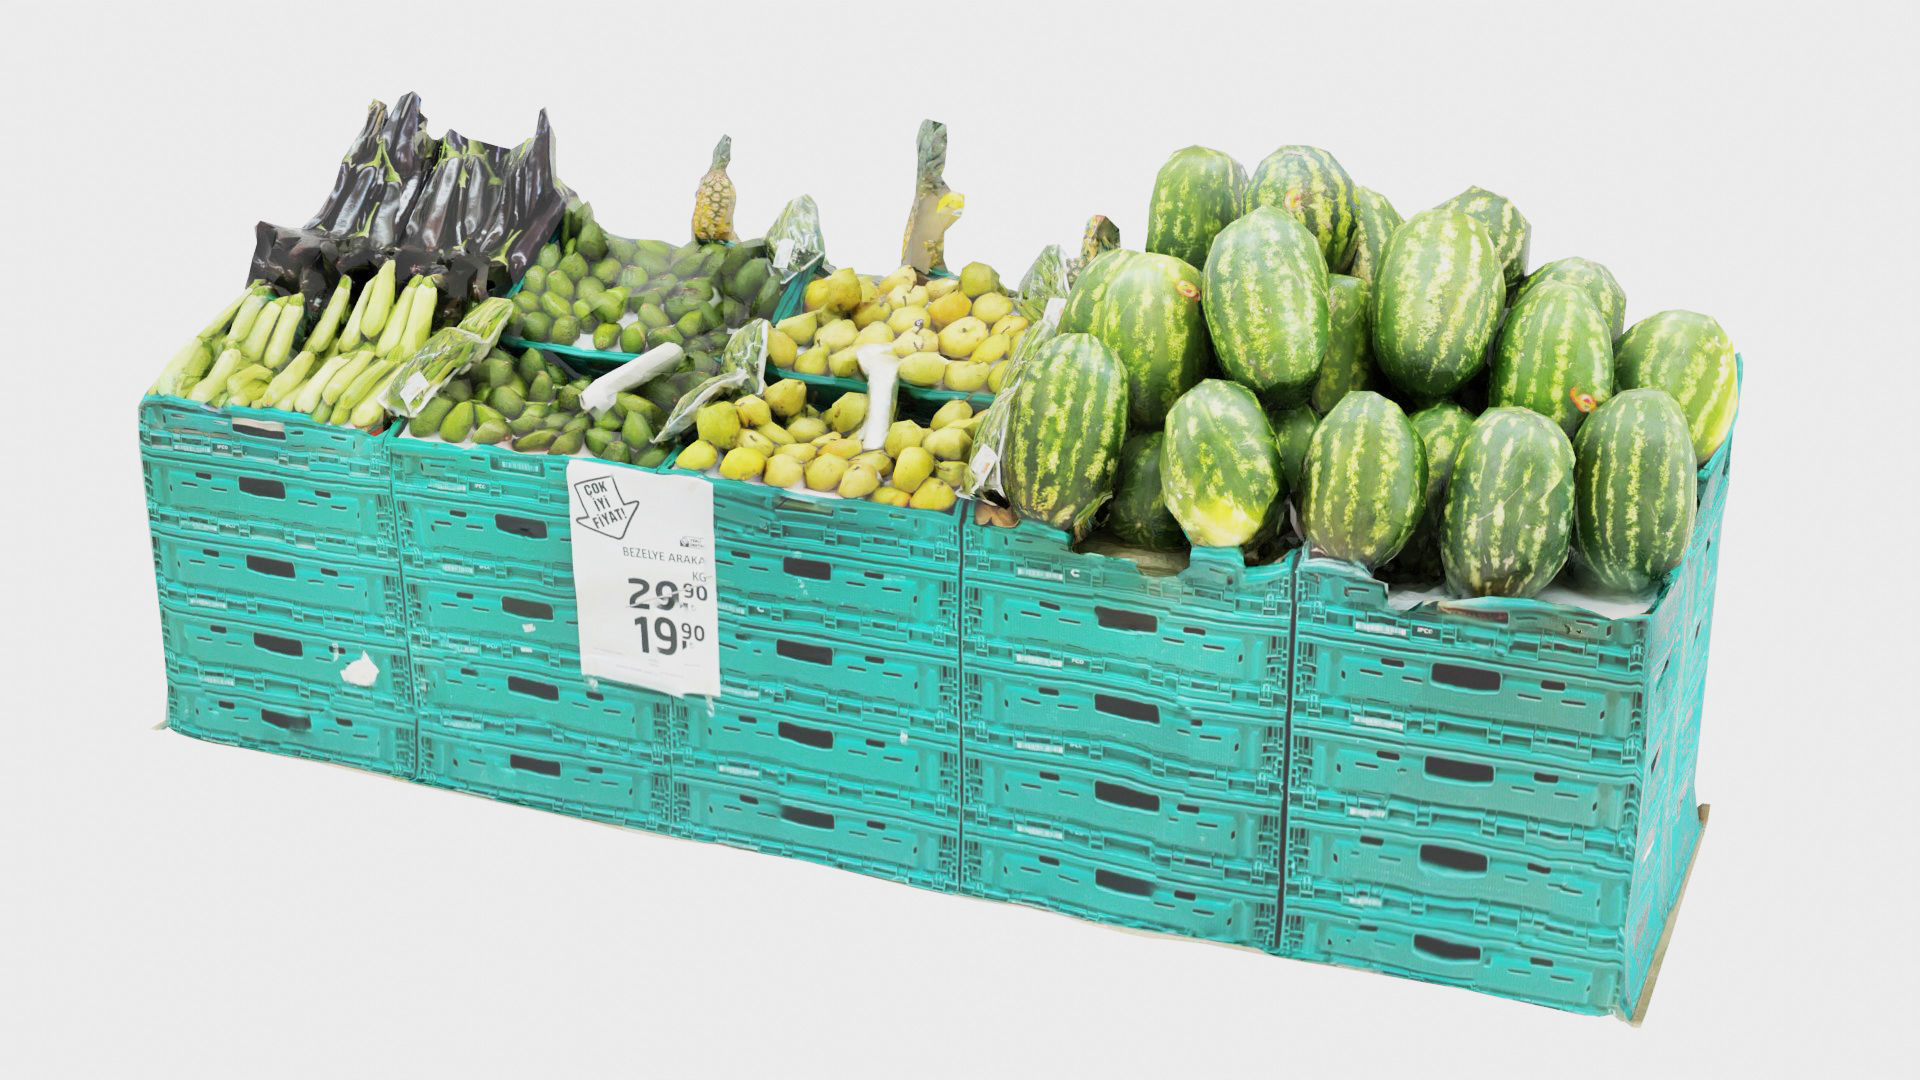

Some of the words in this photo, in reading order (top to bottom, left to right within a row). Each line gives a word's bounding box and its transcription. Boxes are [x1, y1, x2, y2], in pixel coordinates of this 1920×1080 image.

[583, 481, 608, 497] ÇOK
[592, 495, 611, 512] İYİ
[592, 507, 627, 529] FİYAT!
[622, 546, 665, 561] BEZELYE
[692, 571, 707, 582] KG
